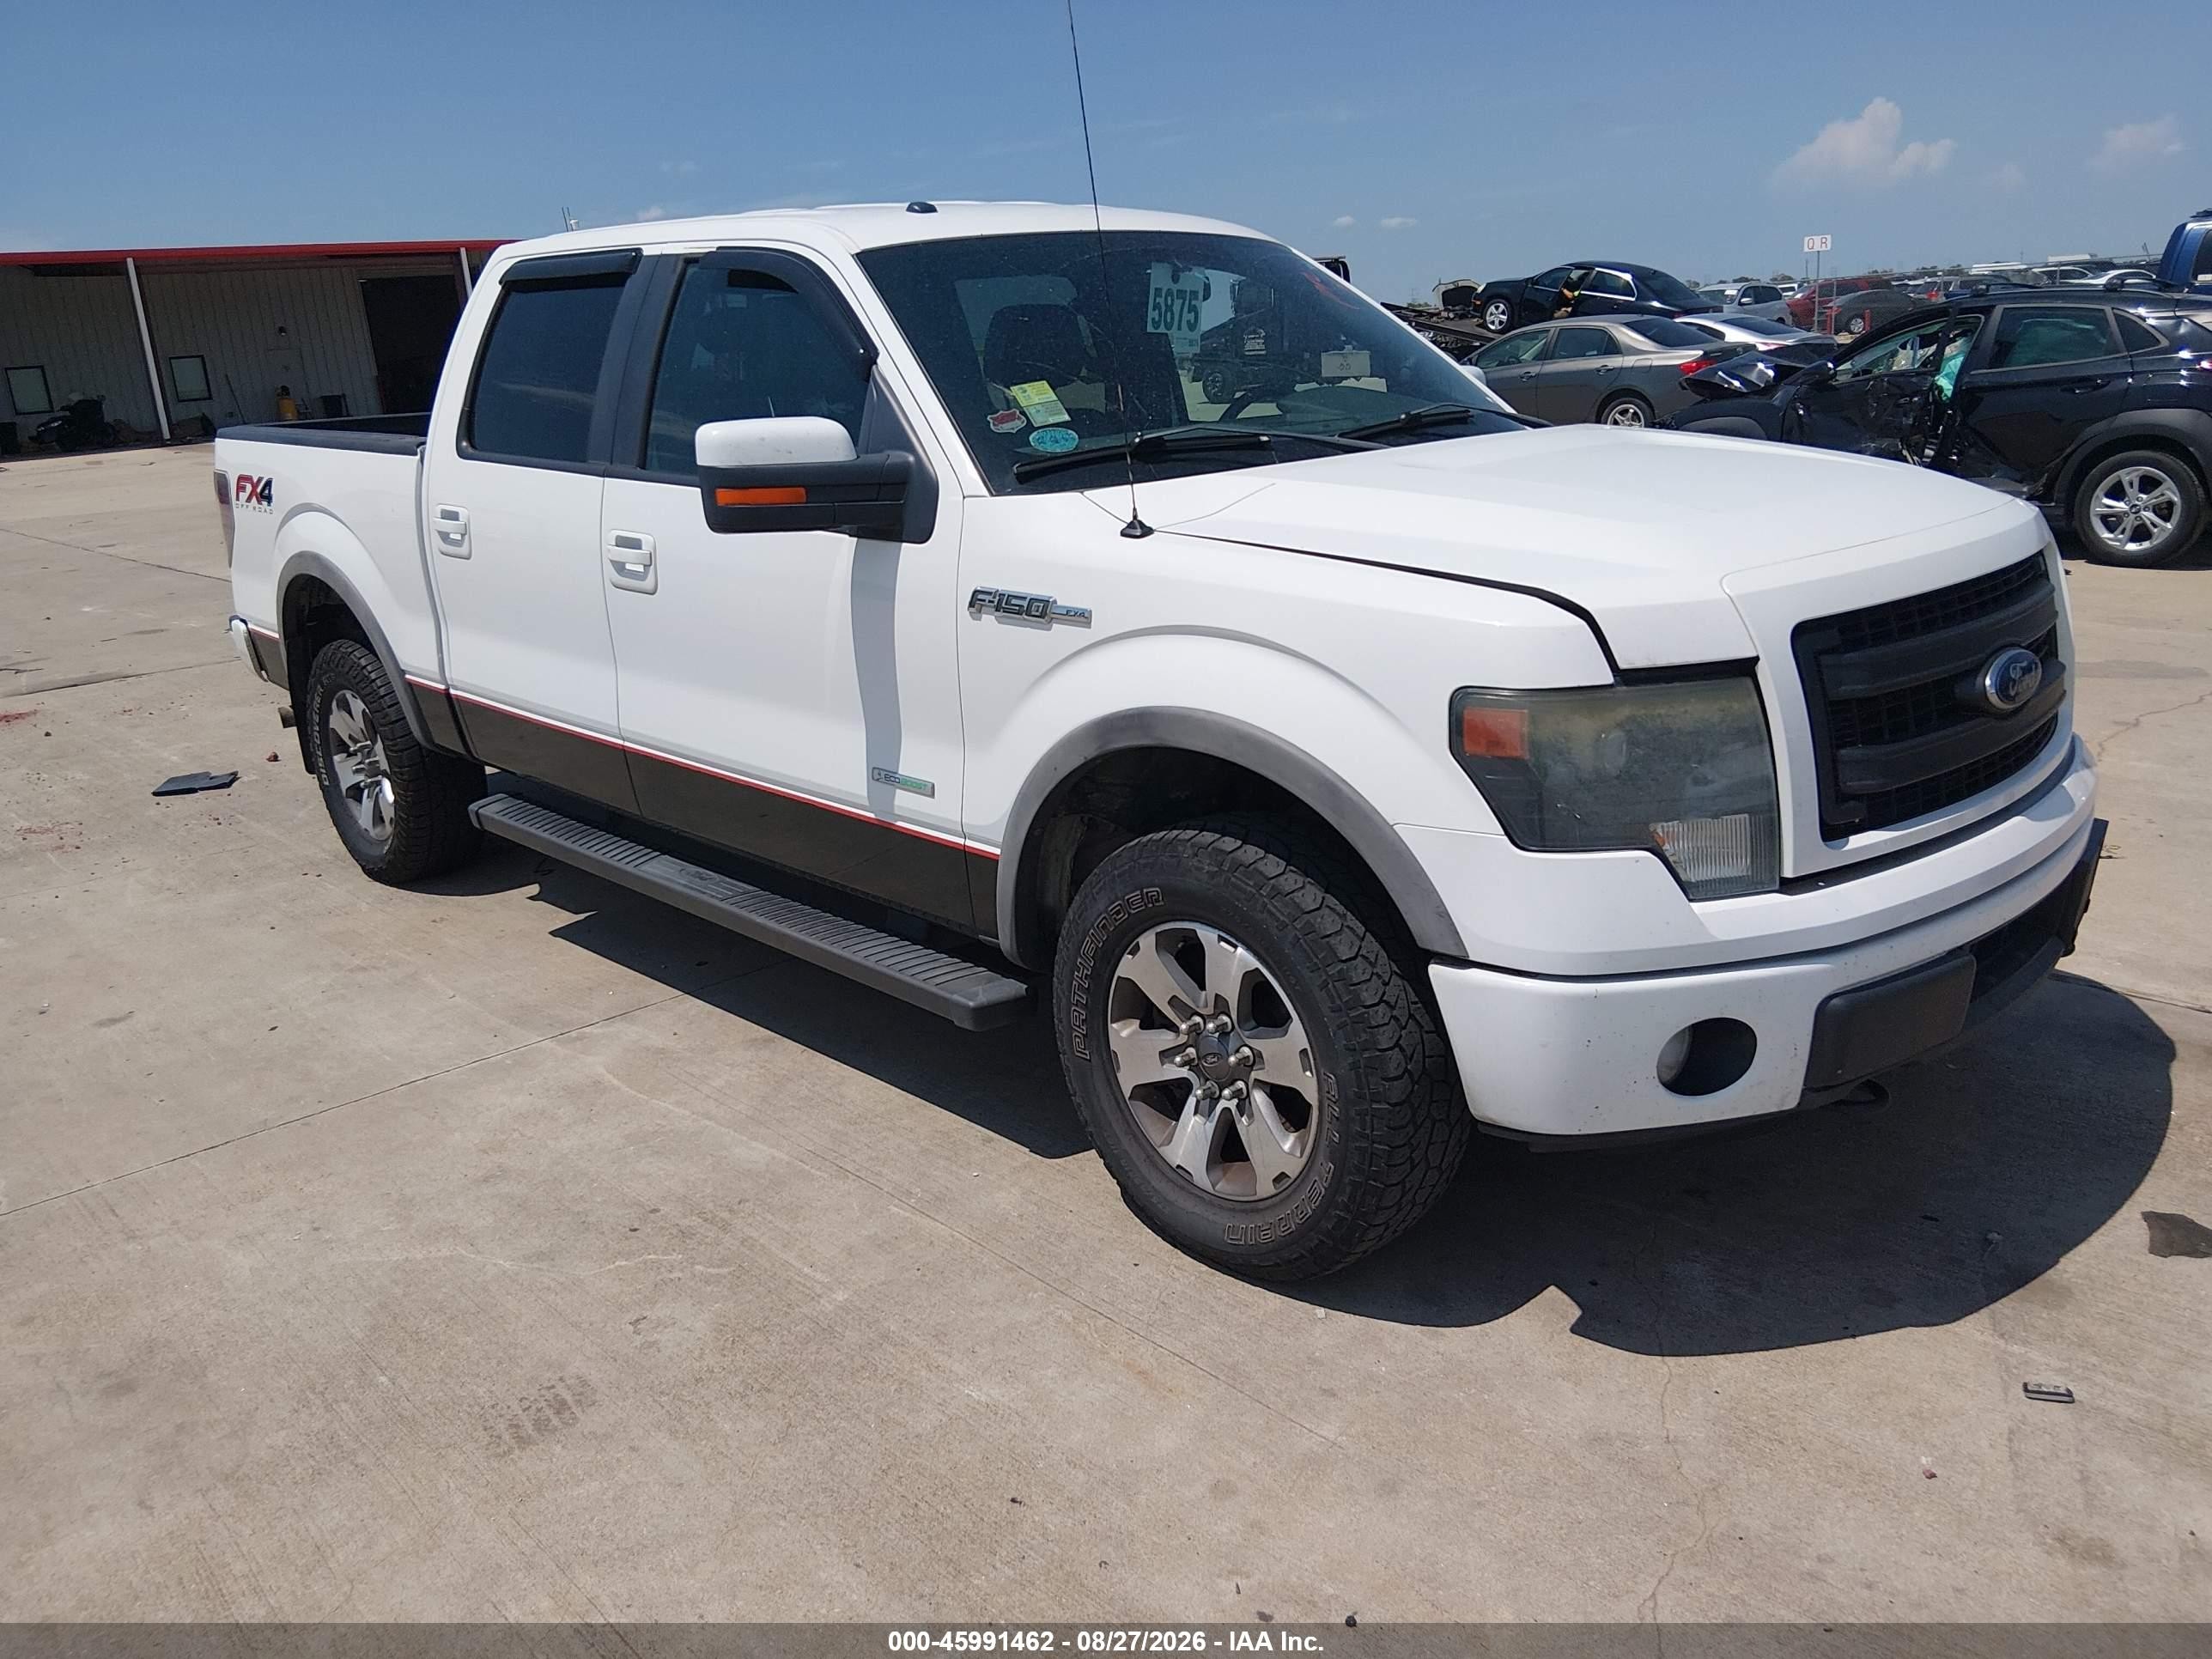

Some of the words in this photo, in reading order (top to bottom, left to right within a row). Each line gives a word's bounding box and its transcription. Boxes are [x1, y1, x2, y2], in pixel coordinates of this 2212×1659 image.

[1820, 236, 1828, 249] R
[1151, 287, 1200, 333] 5875
[235, 473, 274, 507] FX4
[968, 586, 1056, 623] F-150
[1071, 887, 1165, 1062] PATHFINDER
[1323, 1071, 1341, 1146] ALL
[1224, 1161, 1334, 1246] TERRAIN
